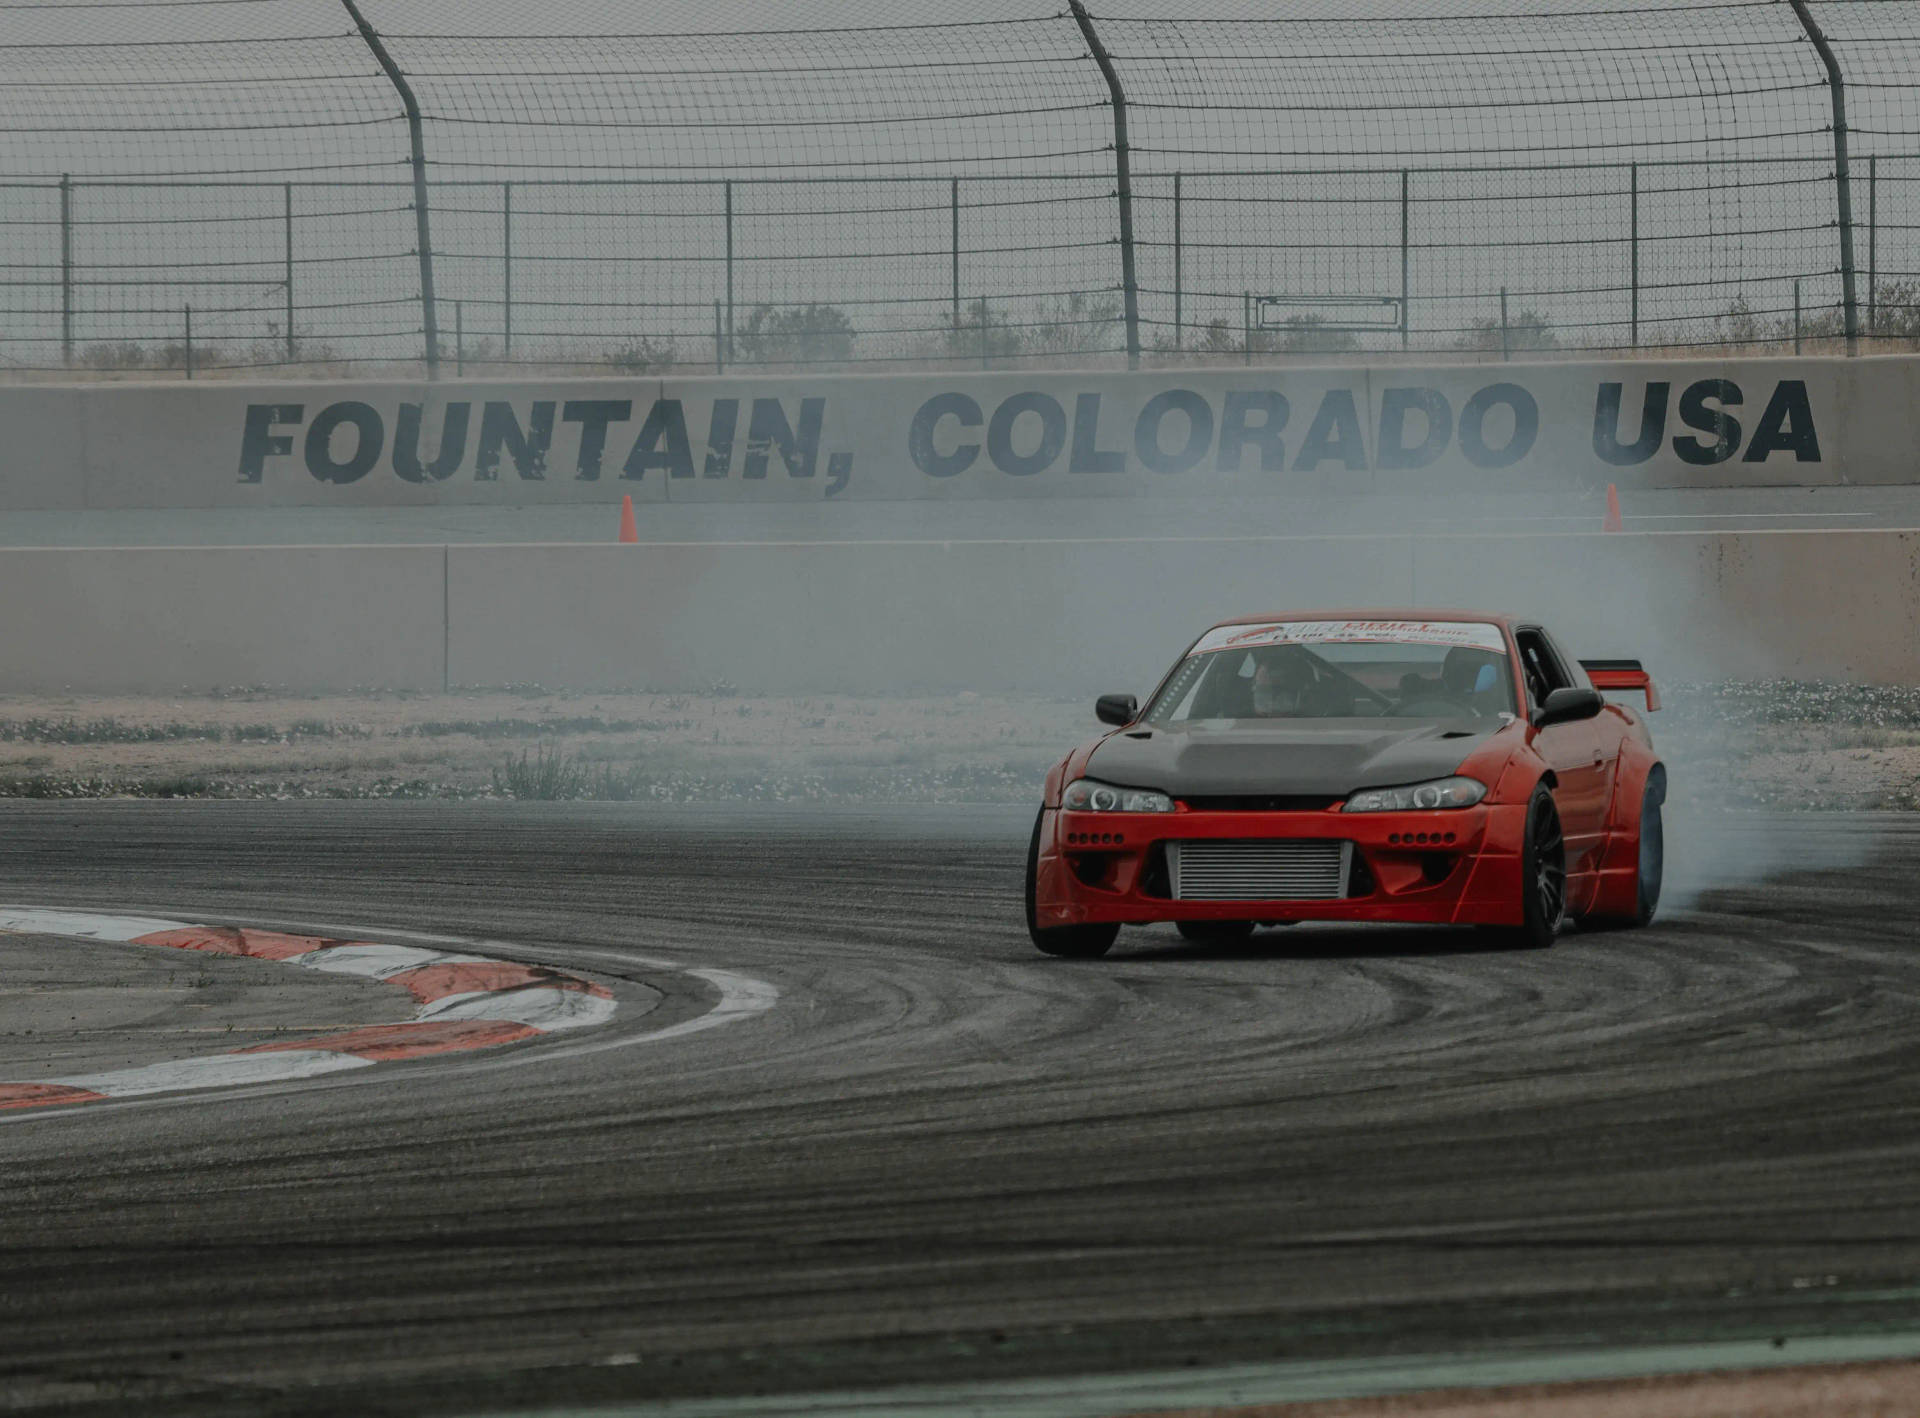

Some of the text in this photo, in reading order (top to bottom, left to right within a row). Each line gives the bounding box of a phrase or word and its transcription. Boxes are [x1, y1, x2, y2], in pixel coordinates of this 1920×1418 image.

[237, 379, 1823, 497] FOUNTAIN, COLORADO USA
